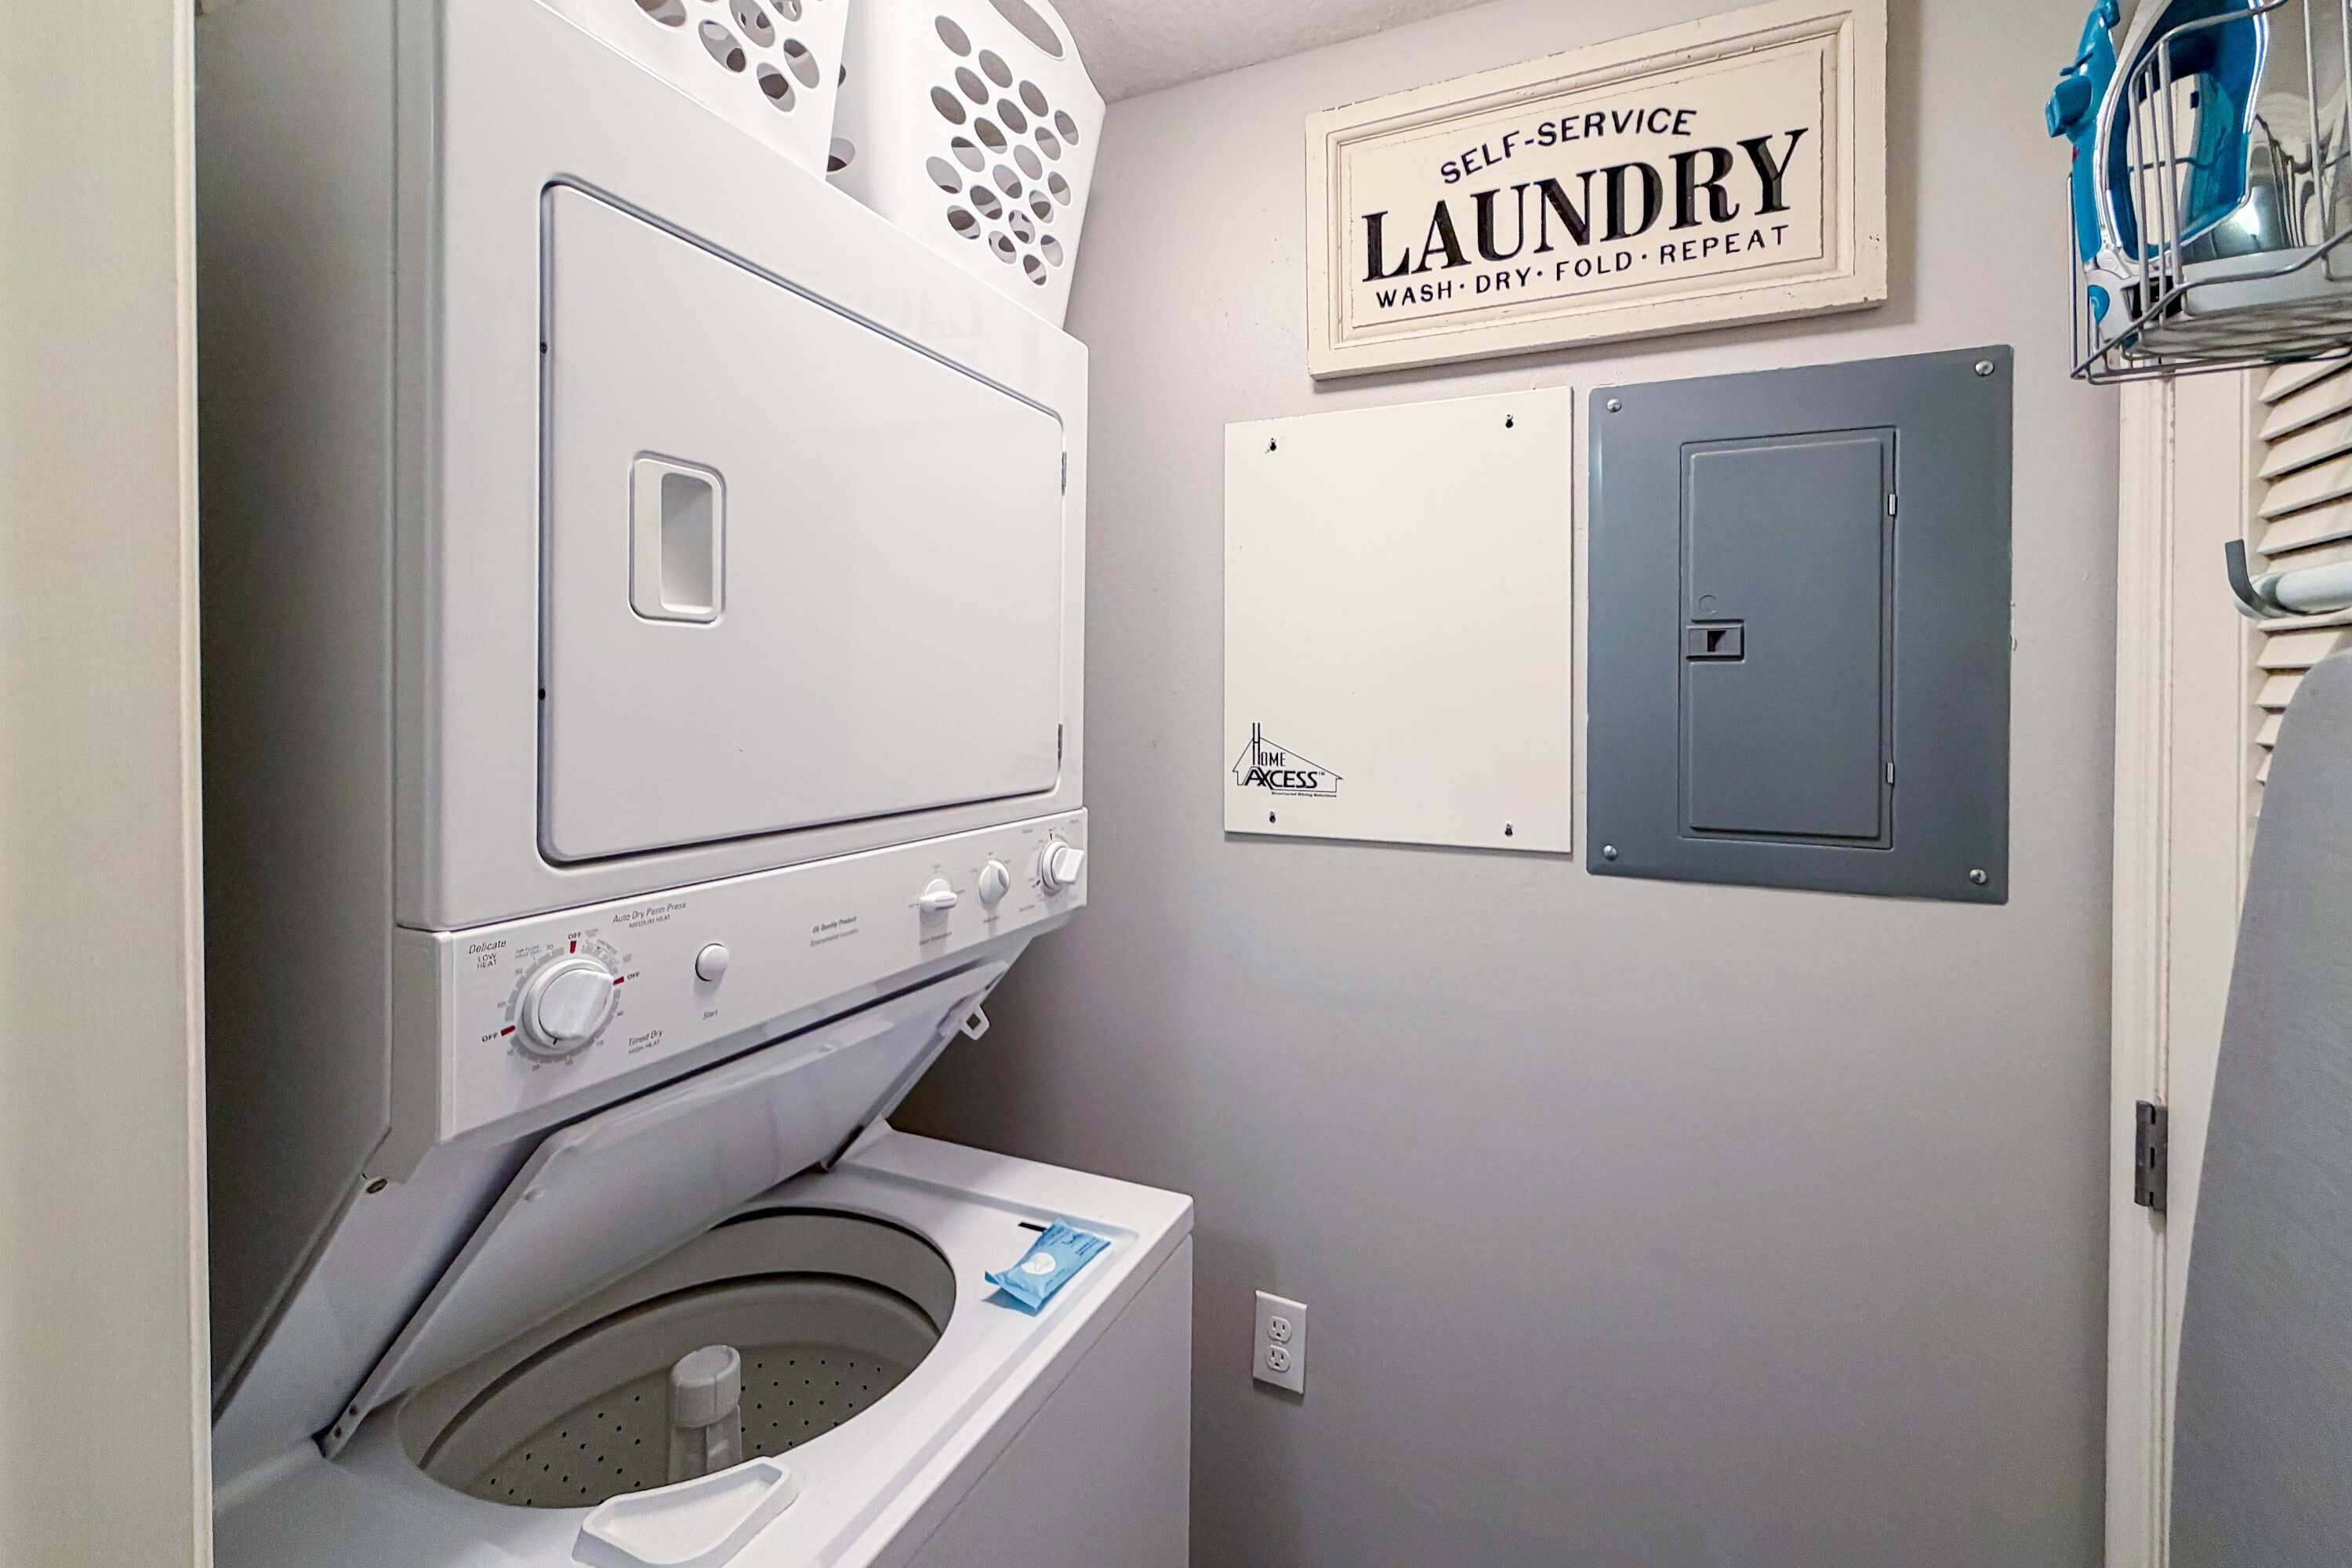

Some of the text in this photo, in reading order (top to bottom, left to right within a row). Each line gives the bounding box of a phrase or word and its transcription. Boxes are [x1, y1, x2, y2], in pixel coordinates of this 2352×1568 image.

[1440, 107, 1697, 185] SELF-SERVICE
[1361, 127, 1809, 283] LAUNDRY
[1376, 224, 1790, 308] WASH DRY FOLD REPEAT
[1252, 722, 1287, 767] HOME
[612, 914, 630, 924] Auto
[632, 910, 644, 920] Dry
[568, 931, 581, 940] OFF
[469, 940, 506, 954] Delicate
[477, 953, 496, 963] LOW
[477, 959, 497, 970] HEAT
[627, 971, 641, 980] OFF
[481, 1032, 499, 1043] OFF
